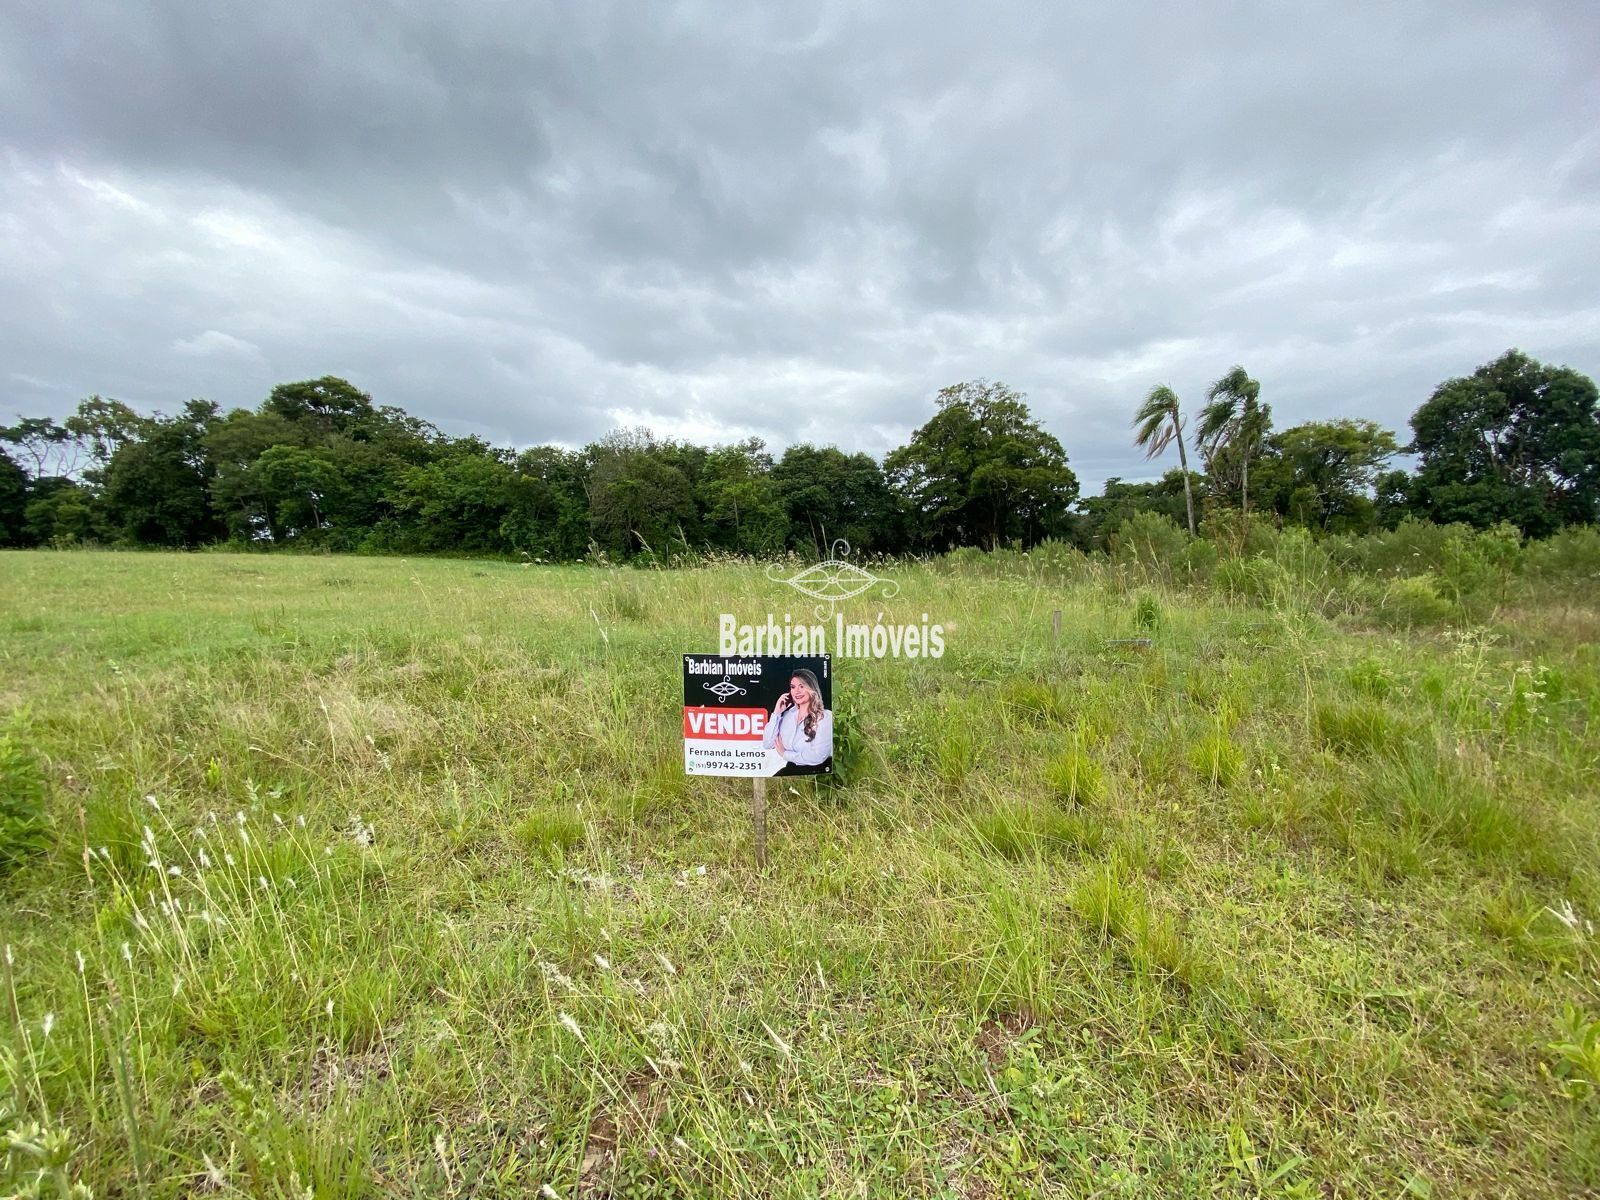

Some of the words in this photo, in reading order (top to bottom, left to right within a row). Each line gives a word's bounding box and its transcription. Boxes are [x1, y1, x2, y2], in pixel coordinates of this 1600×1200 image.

[688, 658, 723, 675] Barbian
[725, 659, 762, 676] Imóveis
[688, 712, 765, 736] VENDE
[689, 747, 732, 757] Fernanda
[735, 749, 766, 758] Lemos
